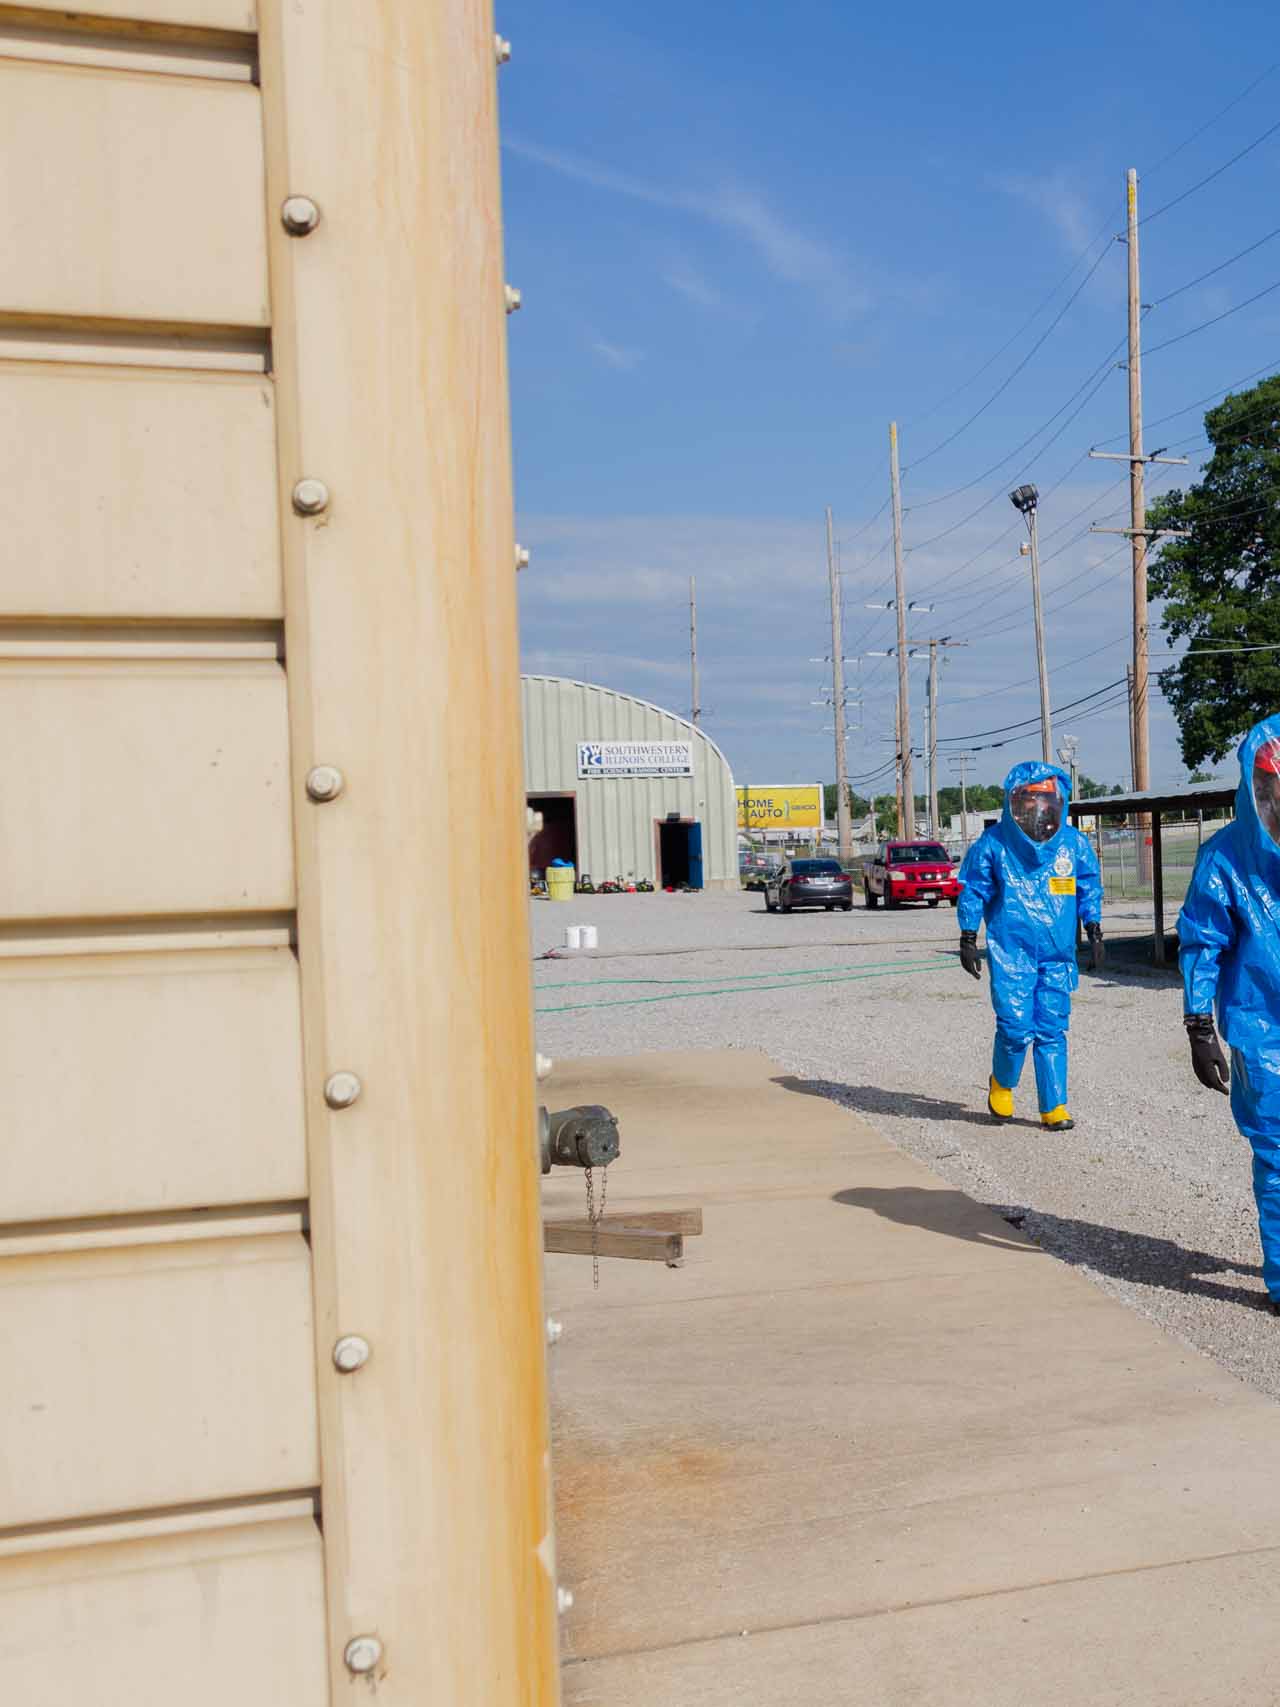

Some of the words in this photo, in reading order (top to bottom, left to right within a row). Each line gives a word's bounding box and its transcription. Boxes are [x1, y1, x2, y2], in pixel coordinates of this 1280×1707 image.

[606, 745, 689, 755] SOUTHWESTERN
[606, 755, 646, 764] ILLINOIS
[648, 755, 688, 763] COLLEGE
[737, 799, 773, 808] HOME
[751, 808, 783, 818] AUTO
